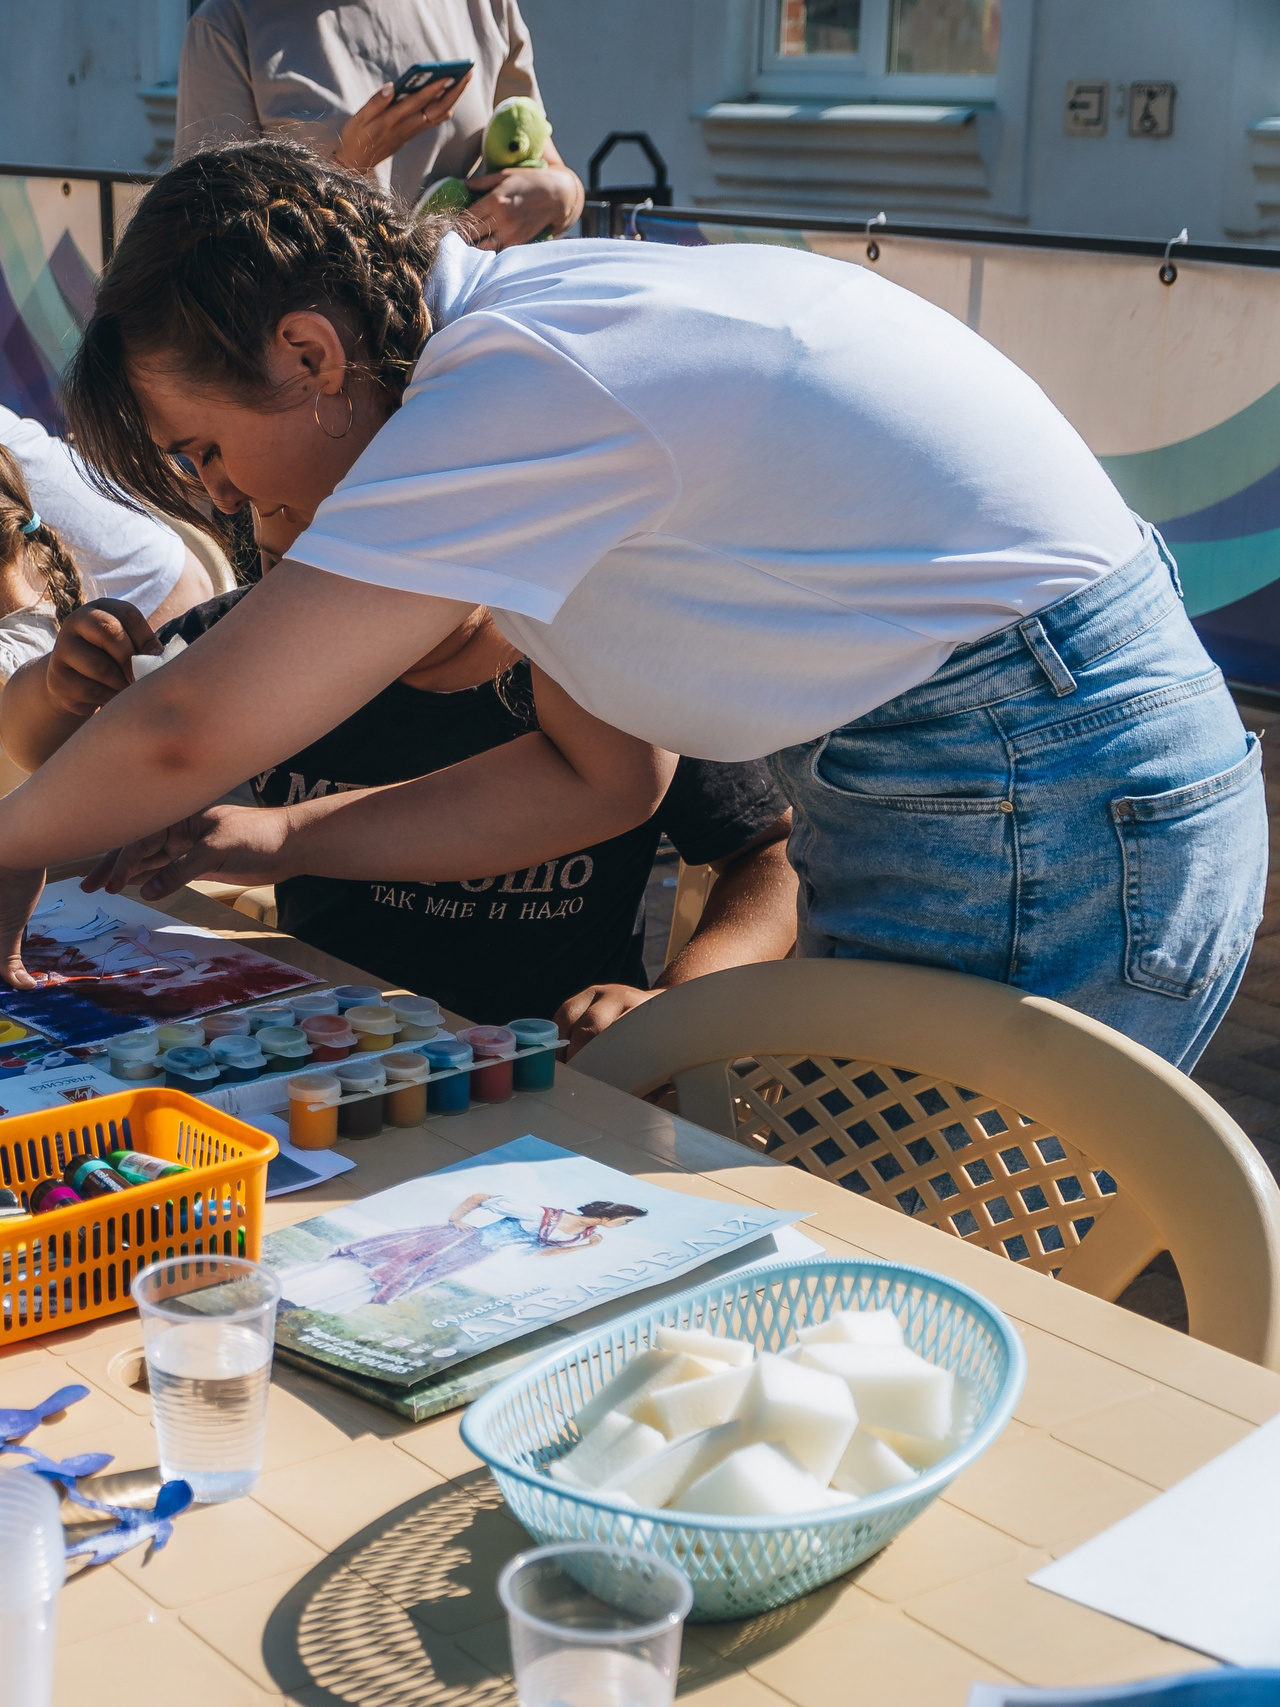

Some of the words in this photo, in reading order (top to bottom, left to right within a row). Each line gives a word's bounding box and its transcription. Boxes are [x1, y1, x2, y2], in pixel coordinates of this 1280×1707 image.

[371, 884, 416, 910] ТАК
[425, 897, 476, 919] МНЕ
[488, 902, 508, 920] И
[519, 897, 584, 920] НАДО
[463, 1214, 764, 1344] АКВАРЕЛИ
